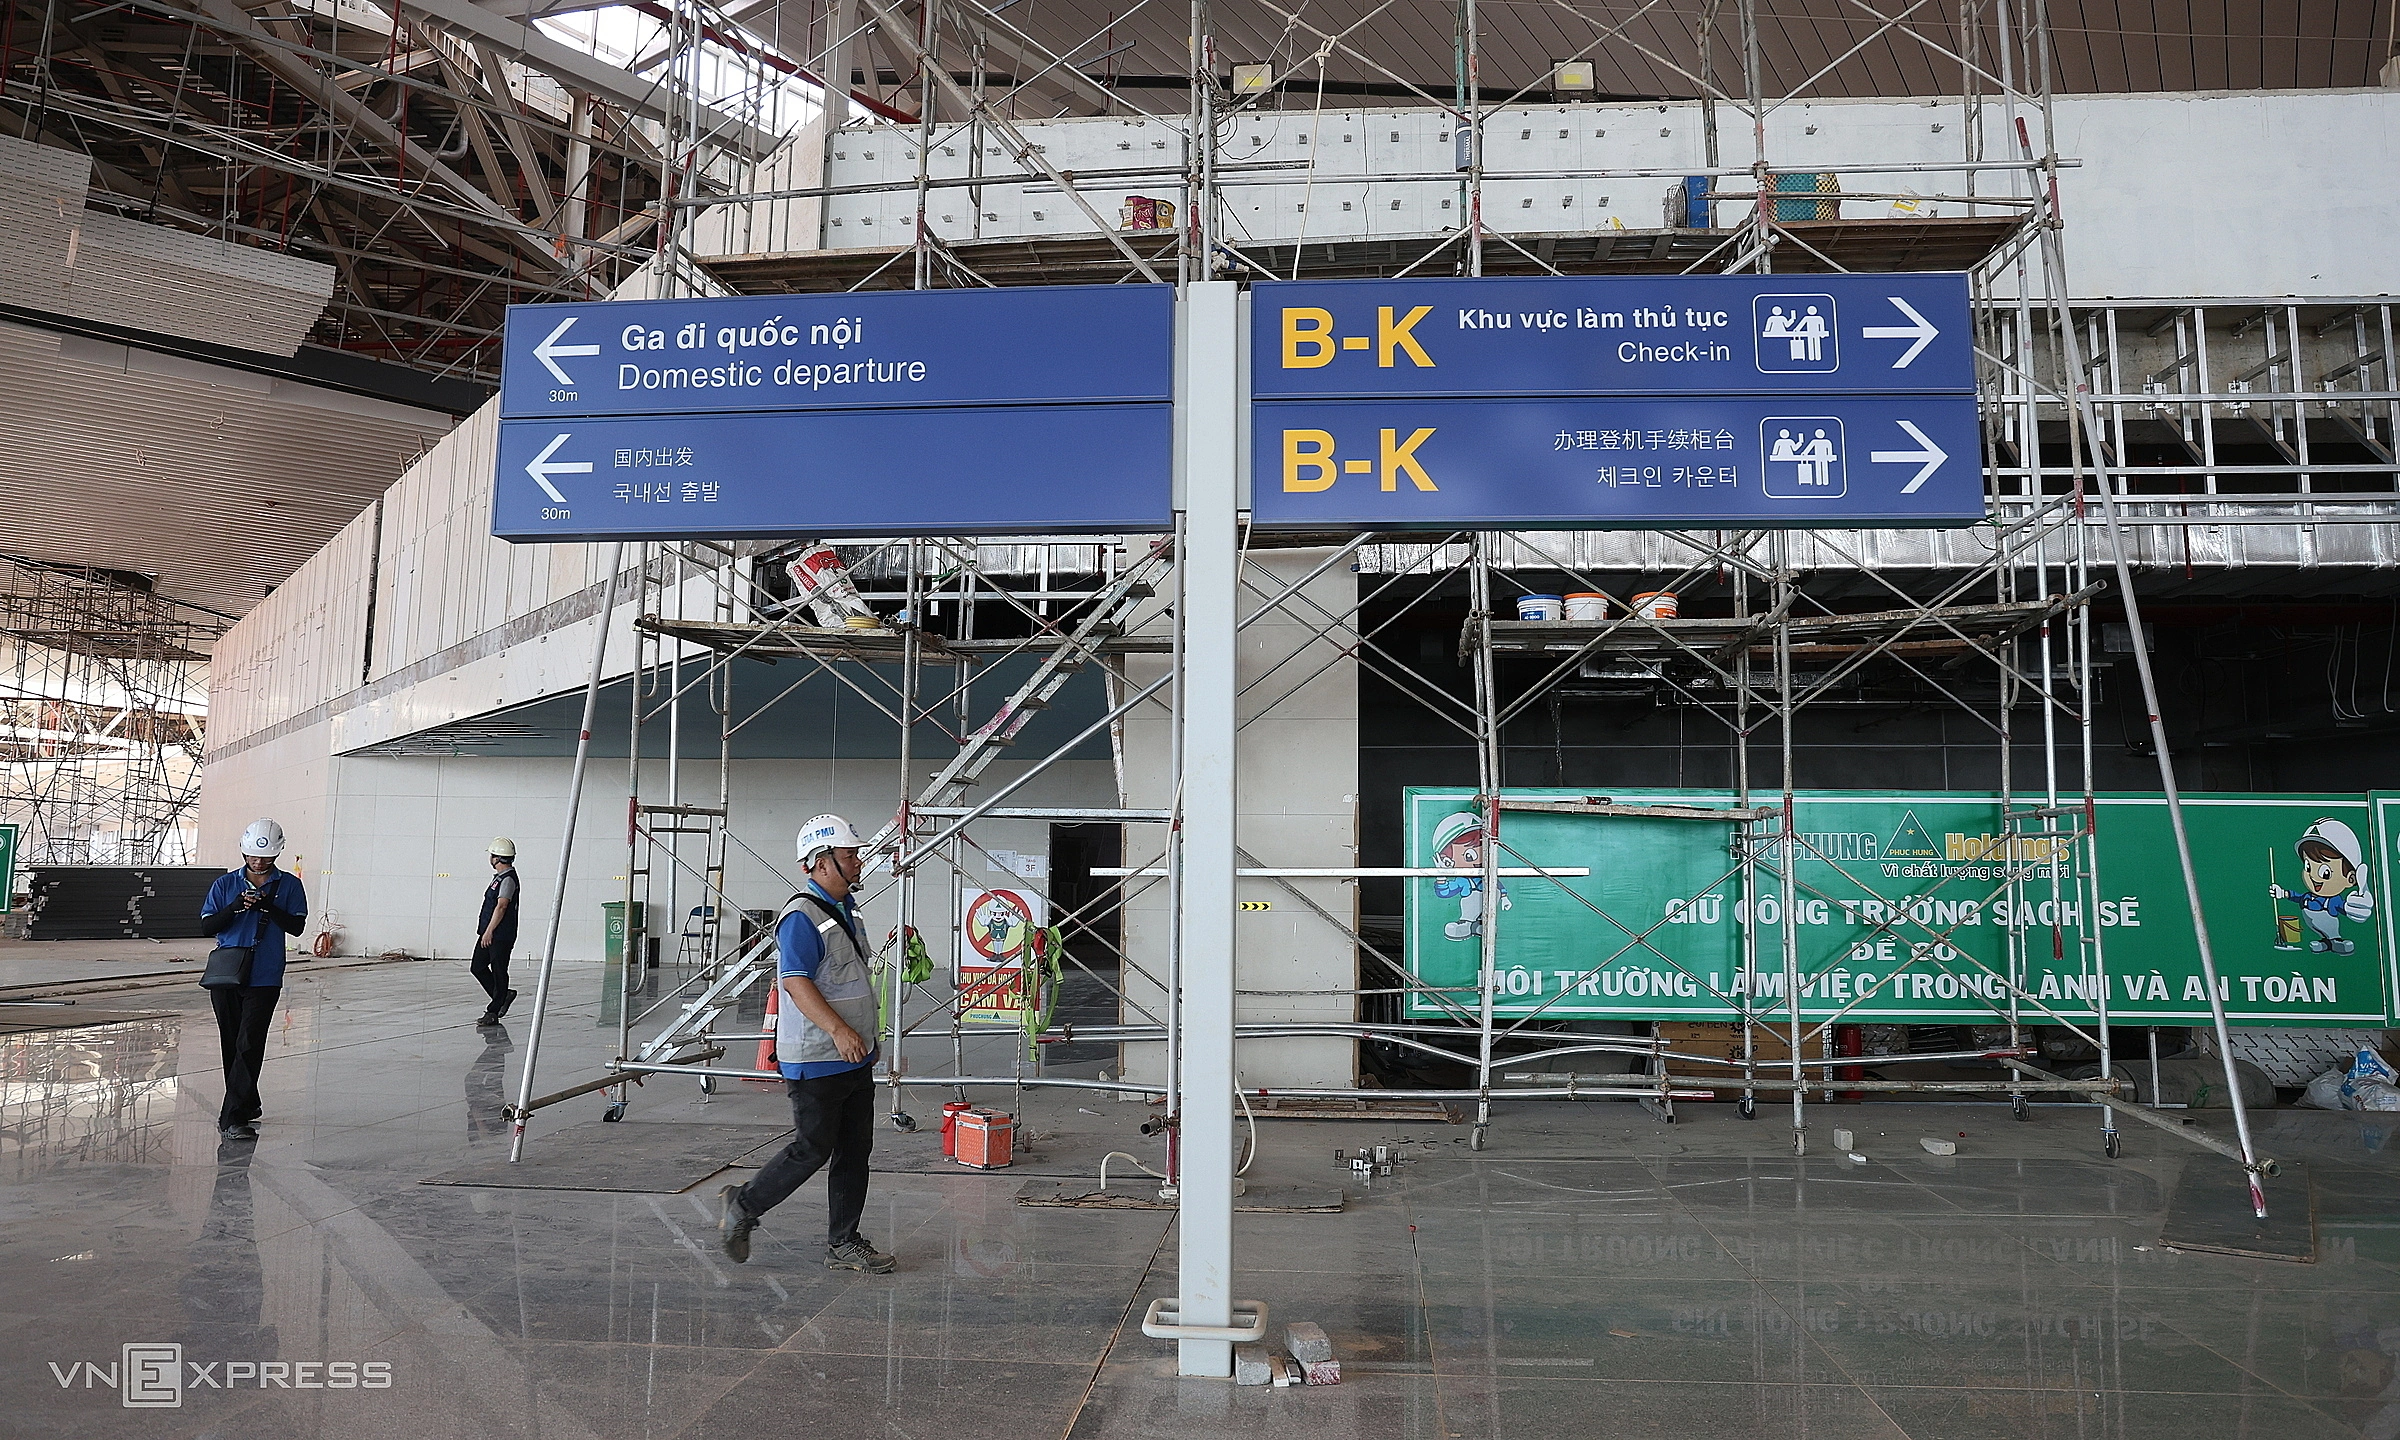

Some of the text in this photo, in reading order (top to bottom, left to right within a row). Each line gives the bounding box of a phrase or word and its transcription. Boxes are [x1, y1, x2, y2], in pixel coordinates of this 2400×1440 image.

[1458, 304, 1728, 333] Khu vực làm thủ tục
[621, 315, 862, 354] Ga đi quốc nội
[1282, 306, 1437, 369] B-K
[1617, 341, 1731, 363] Check-in
[618, 359, 927, 390] Domestic departure
[548, 389, 578, 402] 30m
[1553, 428, 1735, 451] 办理登机手续柜台
[614, 446, 694, 468] 国内出发
[1283, 427, 1440, 493] B-K
[1597, 465, 1738, 489] 체크인 카운터
[613, 480, 720, 503] 국내선 출발
[541, 507, 571, 520] 30m
[815, 826, 835, 839] PMU
[1880, 862, 1899, 878] Vì
[1902, 861, 1937, 878] chất
[1941, 864, 1989, 882] lượng
[1993, 865, 2034, 882] sg
[1665, 894, 1724, 924] GIỮ
[1839, 895, 1982, 926] TRƯỜNG
[1992, 900, 2080, 930] SẠCH
[2100, 897, 2140, 926] SẼ
[1851, 935, 1957, 961] ĐỂ CÓ
[1478, 965, 1542, 996] MÔI
[1554, 966, 1697, 997] TRƯỜNG
[1709, 966, 1785, 998] LÀM
[1798, 968, 1877, 1003] VIỆC
[1891, 972, 2006, 1000] TRONG
[2018, 968, 2111, 1000] LÀNH
[2122, 969, 2169, 1001] VÀ
[2240, 971, 2336, 1003] TOÀN
[960, 988, 1031, 1010] CẤM VÀ
